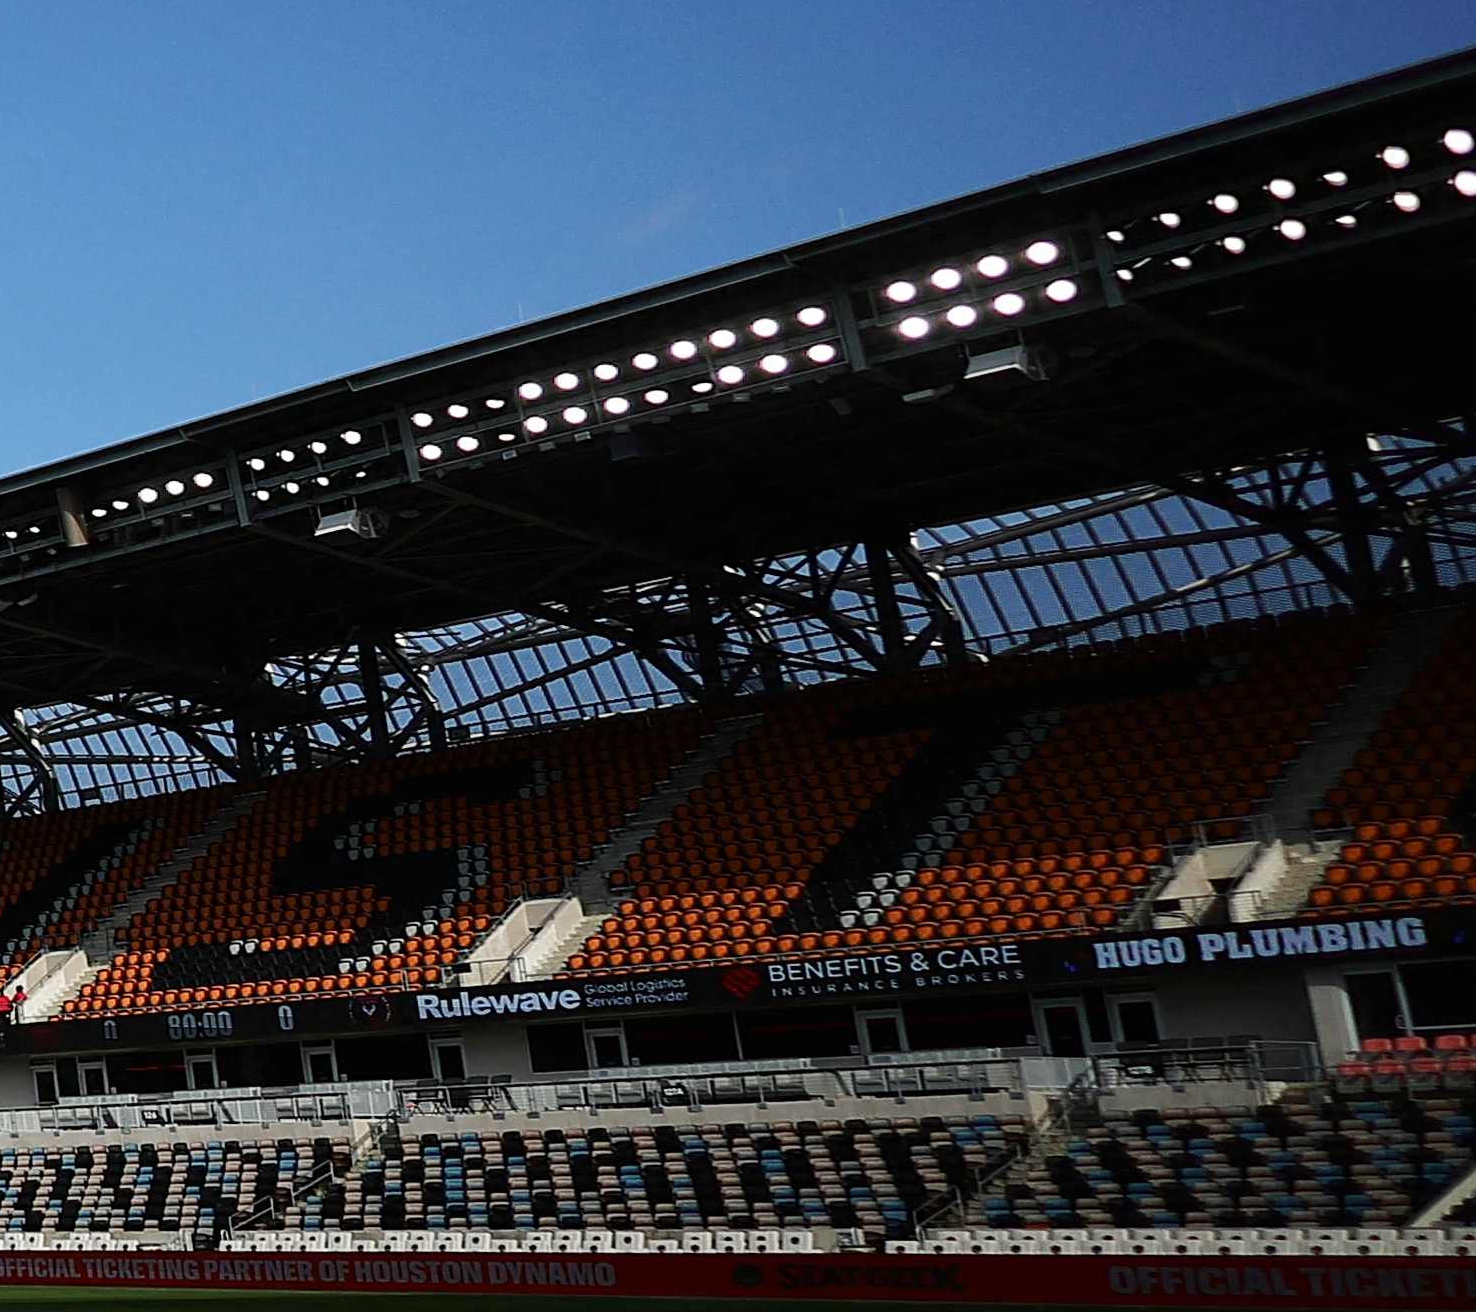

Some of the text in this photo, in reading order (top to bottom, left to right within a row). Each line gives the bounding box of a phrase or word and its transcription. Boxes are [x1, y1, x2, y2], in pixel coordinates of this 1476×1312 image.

[1093, 916, 1429, 969] HUGO PLUMBING
[767, 944, 1022, 982] BENEFITS & CARE
[584, 978, 687, 995] Global Logistics
[585, 990, 690, 1007] Service Provider
[770, 968, 1026, 998] INSURANCE BROKERS
[417, 988, 582, 1021] Rulewave
[168, 1011, 235, 1040] 80:00
[278, 1004, 296, 1031] 0
[81, 1258, 201, 1280] TICKETING
[203, 1259, 314, 1282] PARTNER
[318, 1259, 350, 1282] OF
[354, 1260, 483, 1284] HOUSTON
[487, 1262, 617, 1286] DYNAMO
[1108, 1265, 1299, 1296] OFFICIAL
